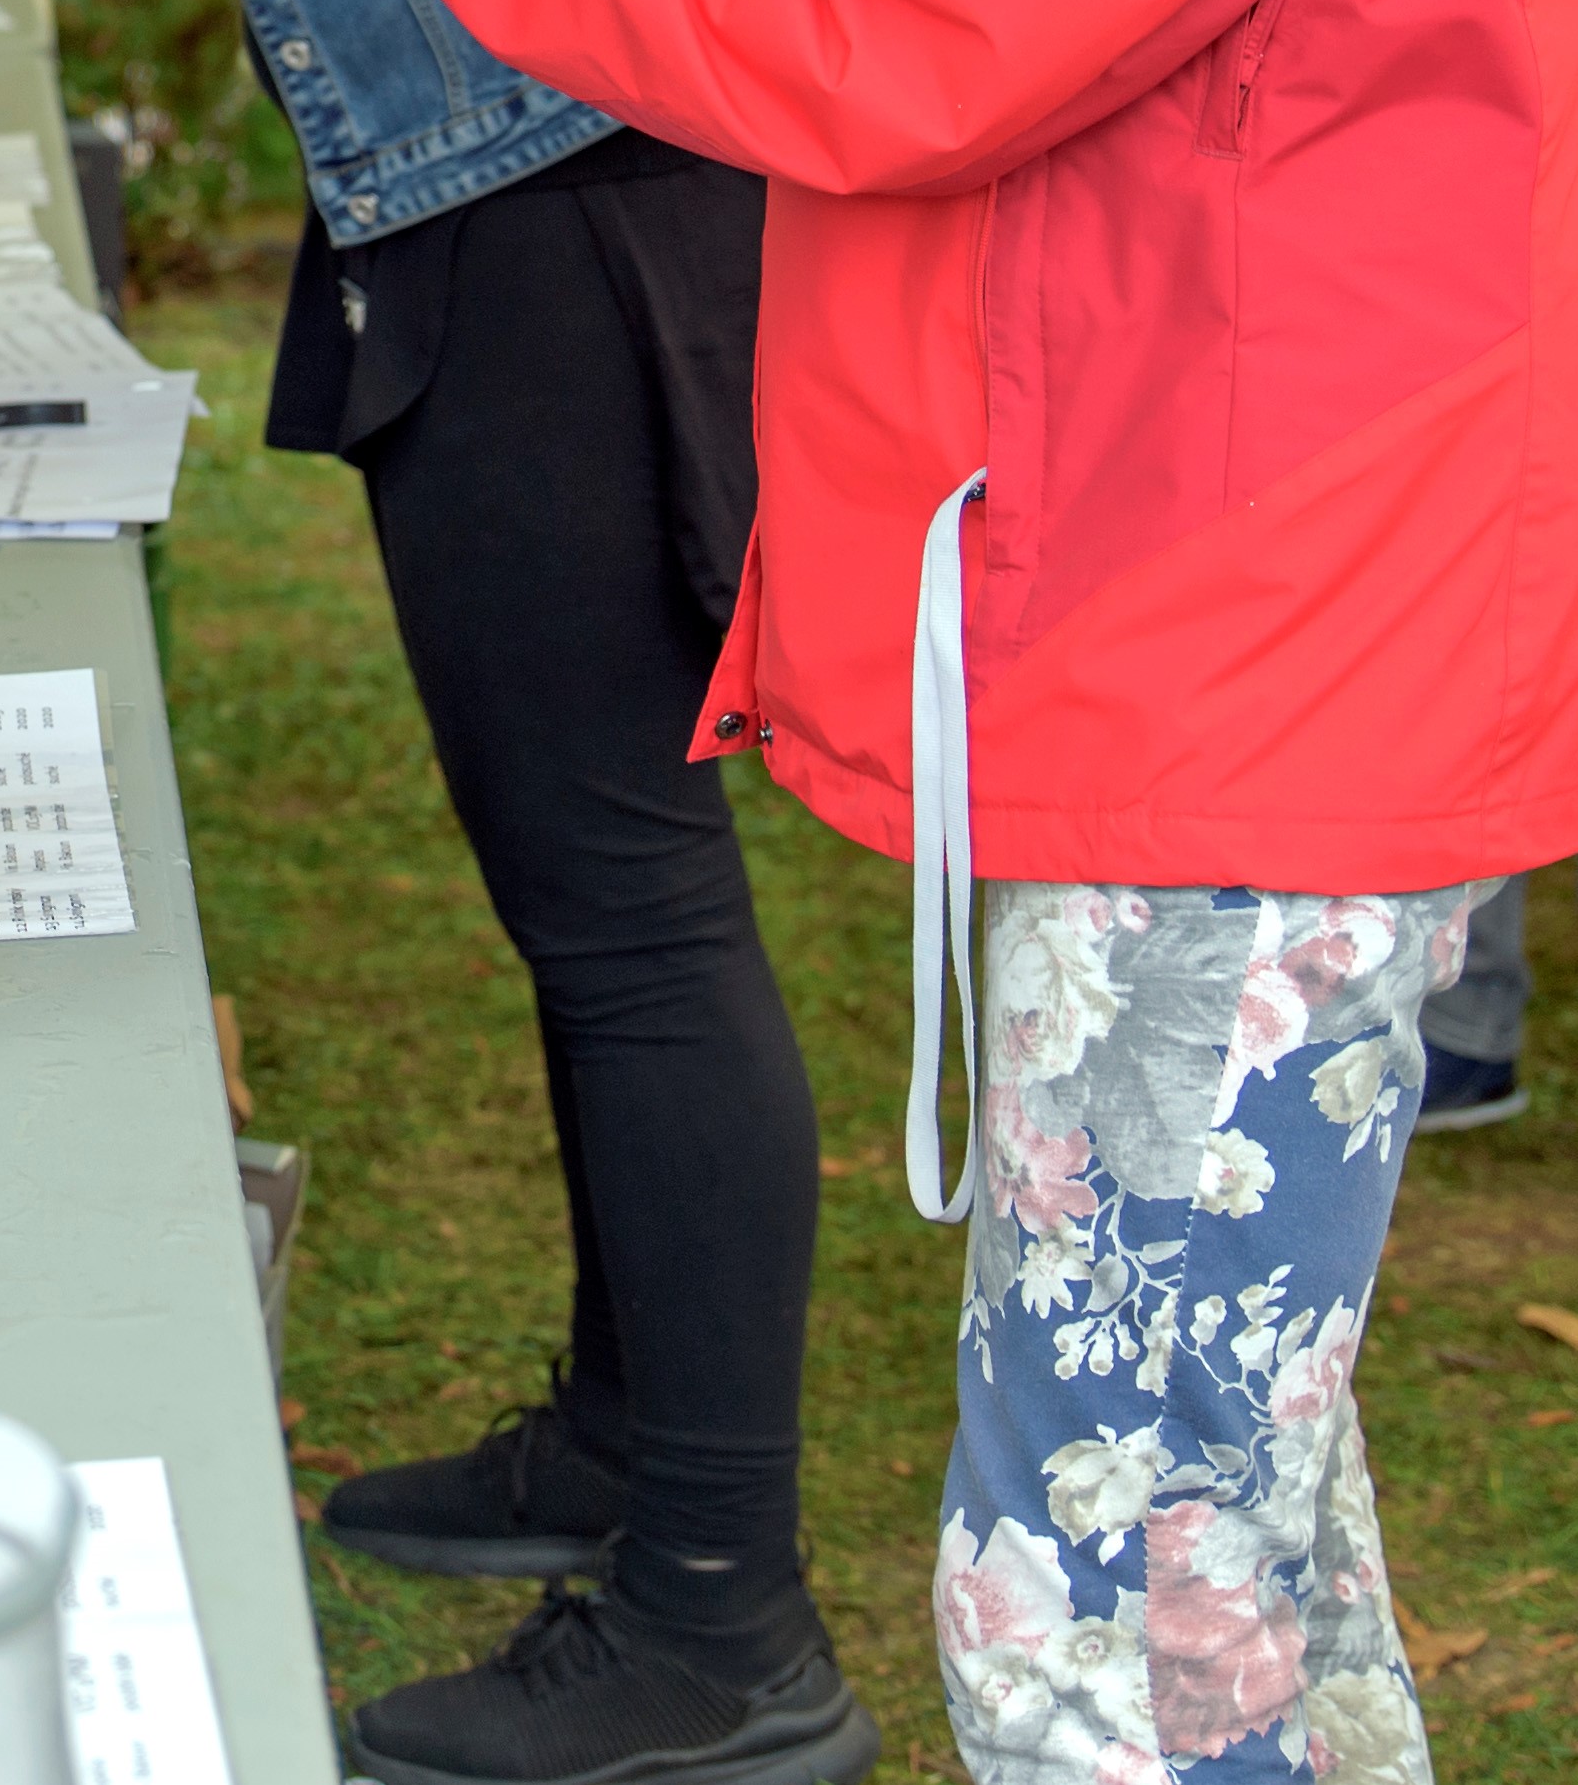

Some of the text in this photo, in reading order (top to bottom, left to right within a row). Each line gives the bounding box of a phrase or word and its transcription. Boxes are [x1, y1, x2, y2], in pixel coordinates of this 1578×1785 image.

[16, 708, 28, 730] 2020
[42, 707, 54, 728] 2020
[16, 923, 27, 933] 12
